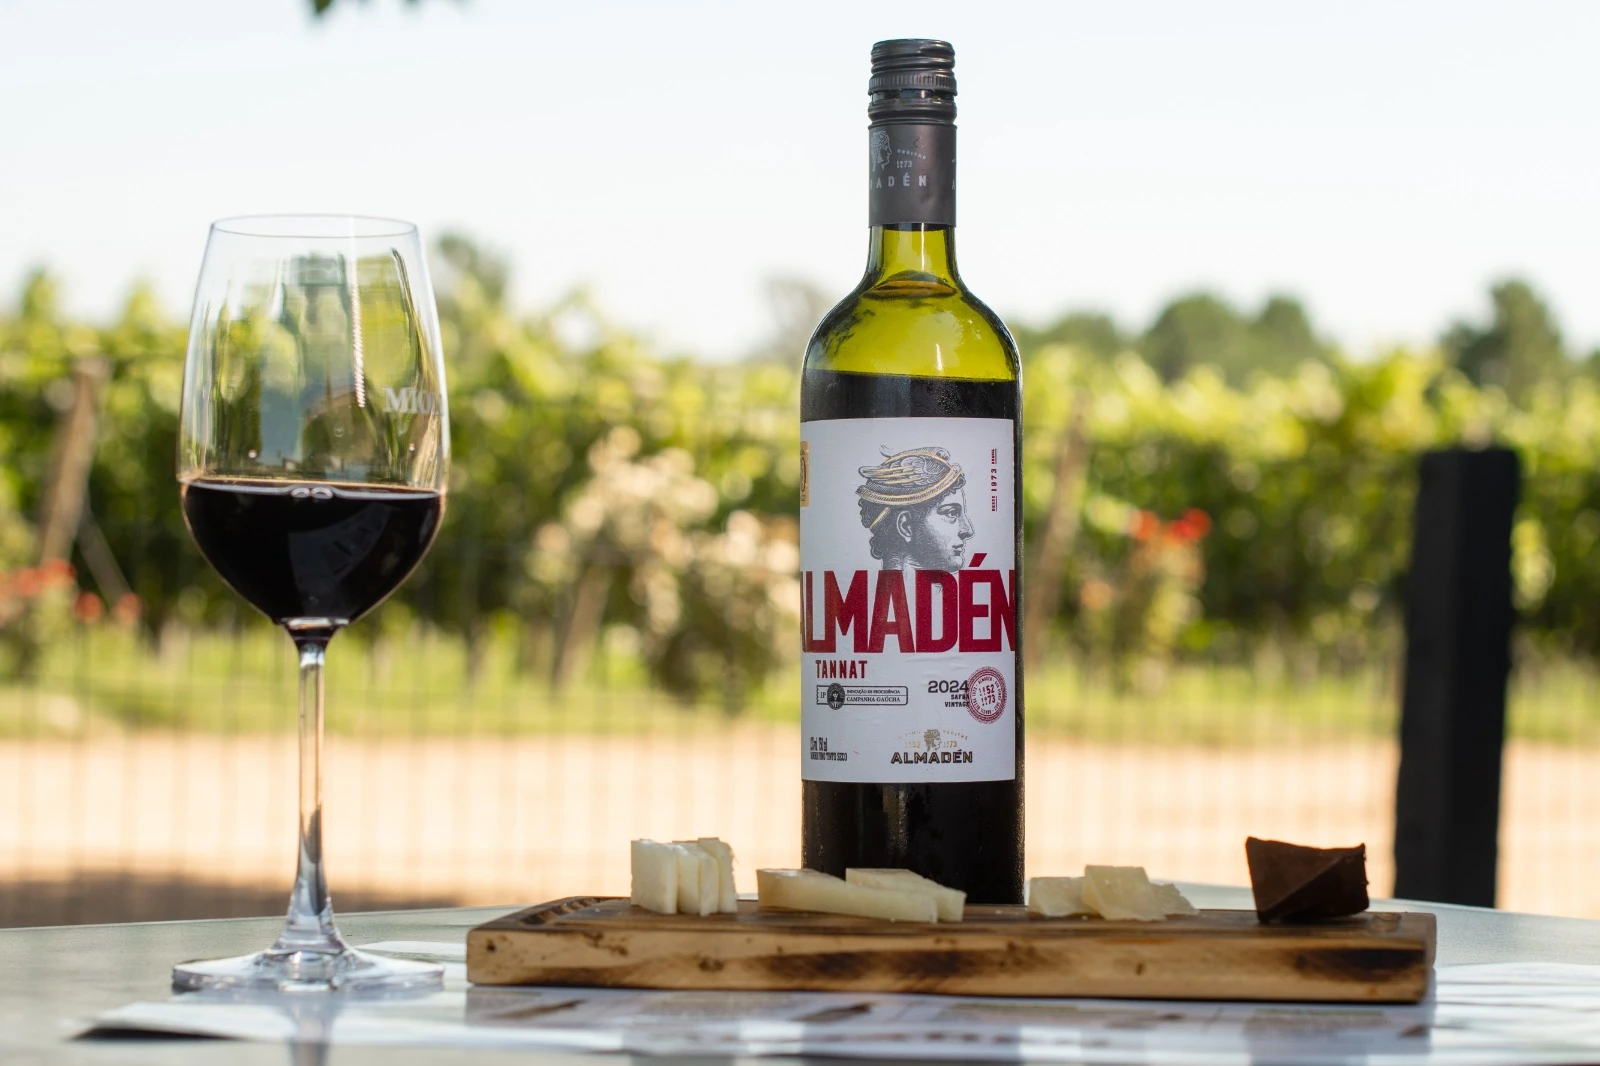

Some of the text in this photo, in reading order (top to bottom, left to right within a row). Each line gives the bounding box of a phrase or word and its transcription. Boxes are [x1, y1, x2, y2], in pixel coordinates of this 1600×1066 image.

[815, 660, 868, 679] TANNAT
[928, 680, 969, 693] 2024
[890, 749, 973, 764] ALMADÉN
